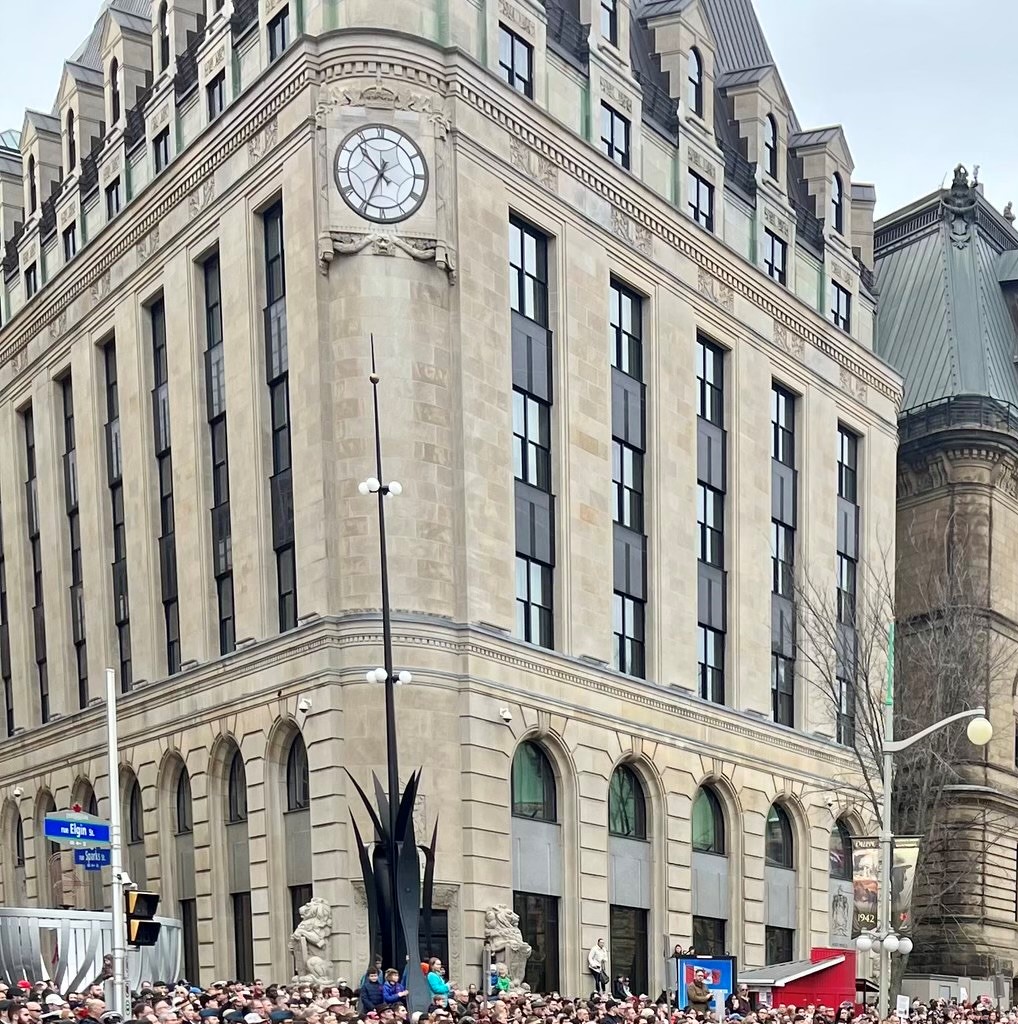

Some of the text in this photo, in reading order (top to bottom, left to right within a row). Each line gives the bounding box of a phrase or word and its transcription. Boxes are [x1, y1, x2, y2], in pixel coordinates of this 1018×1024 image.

[69, 823, 87, 838] Elgin
[84, 851, 101, 864] Sparks
[857, 913, 875, 923] 1942
